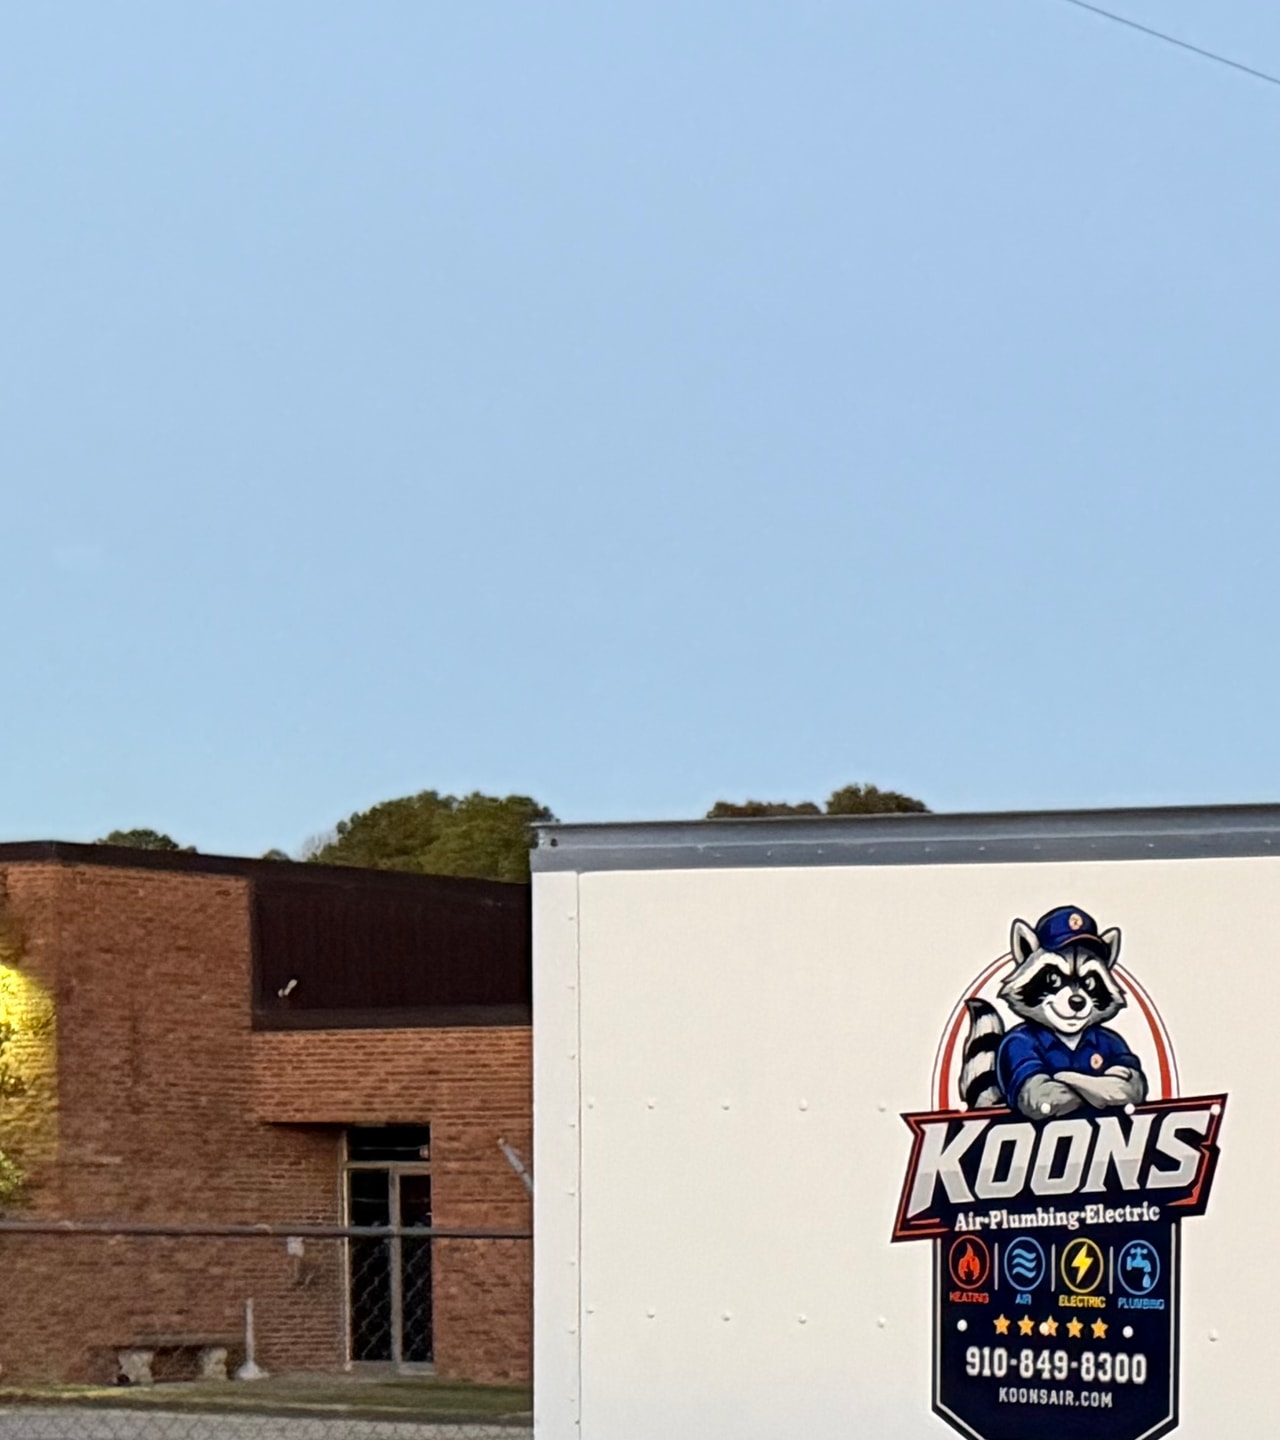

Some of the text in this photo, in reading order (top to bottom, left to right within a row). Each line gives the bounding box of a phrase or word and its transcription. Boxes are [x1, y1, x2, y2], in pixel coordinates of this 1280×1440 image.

[906, 1110, 1210, 1218] KOONS
[1015, 1294, 1032, 1305] AIR
[1058, 1295, 1106, 1308] ELECTRIC
[965, 1346, 1148, 1385] 910-849-8300
[998, 1387, 1113, 1408] KOONSAIR.COM
